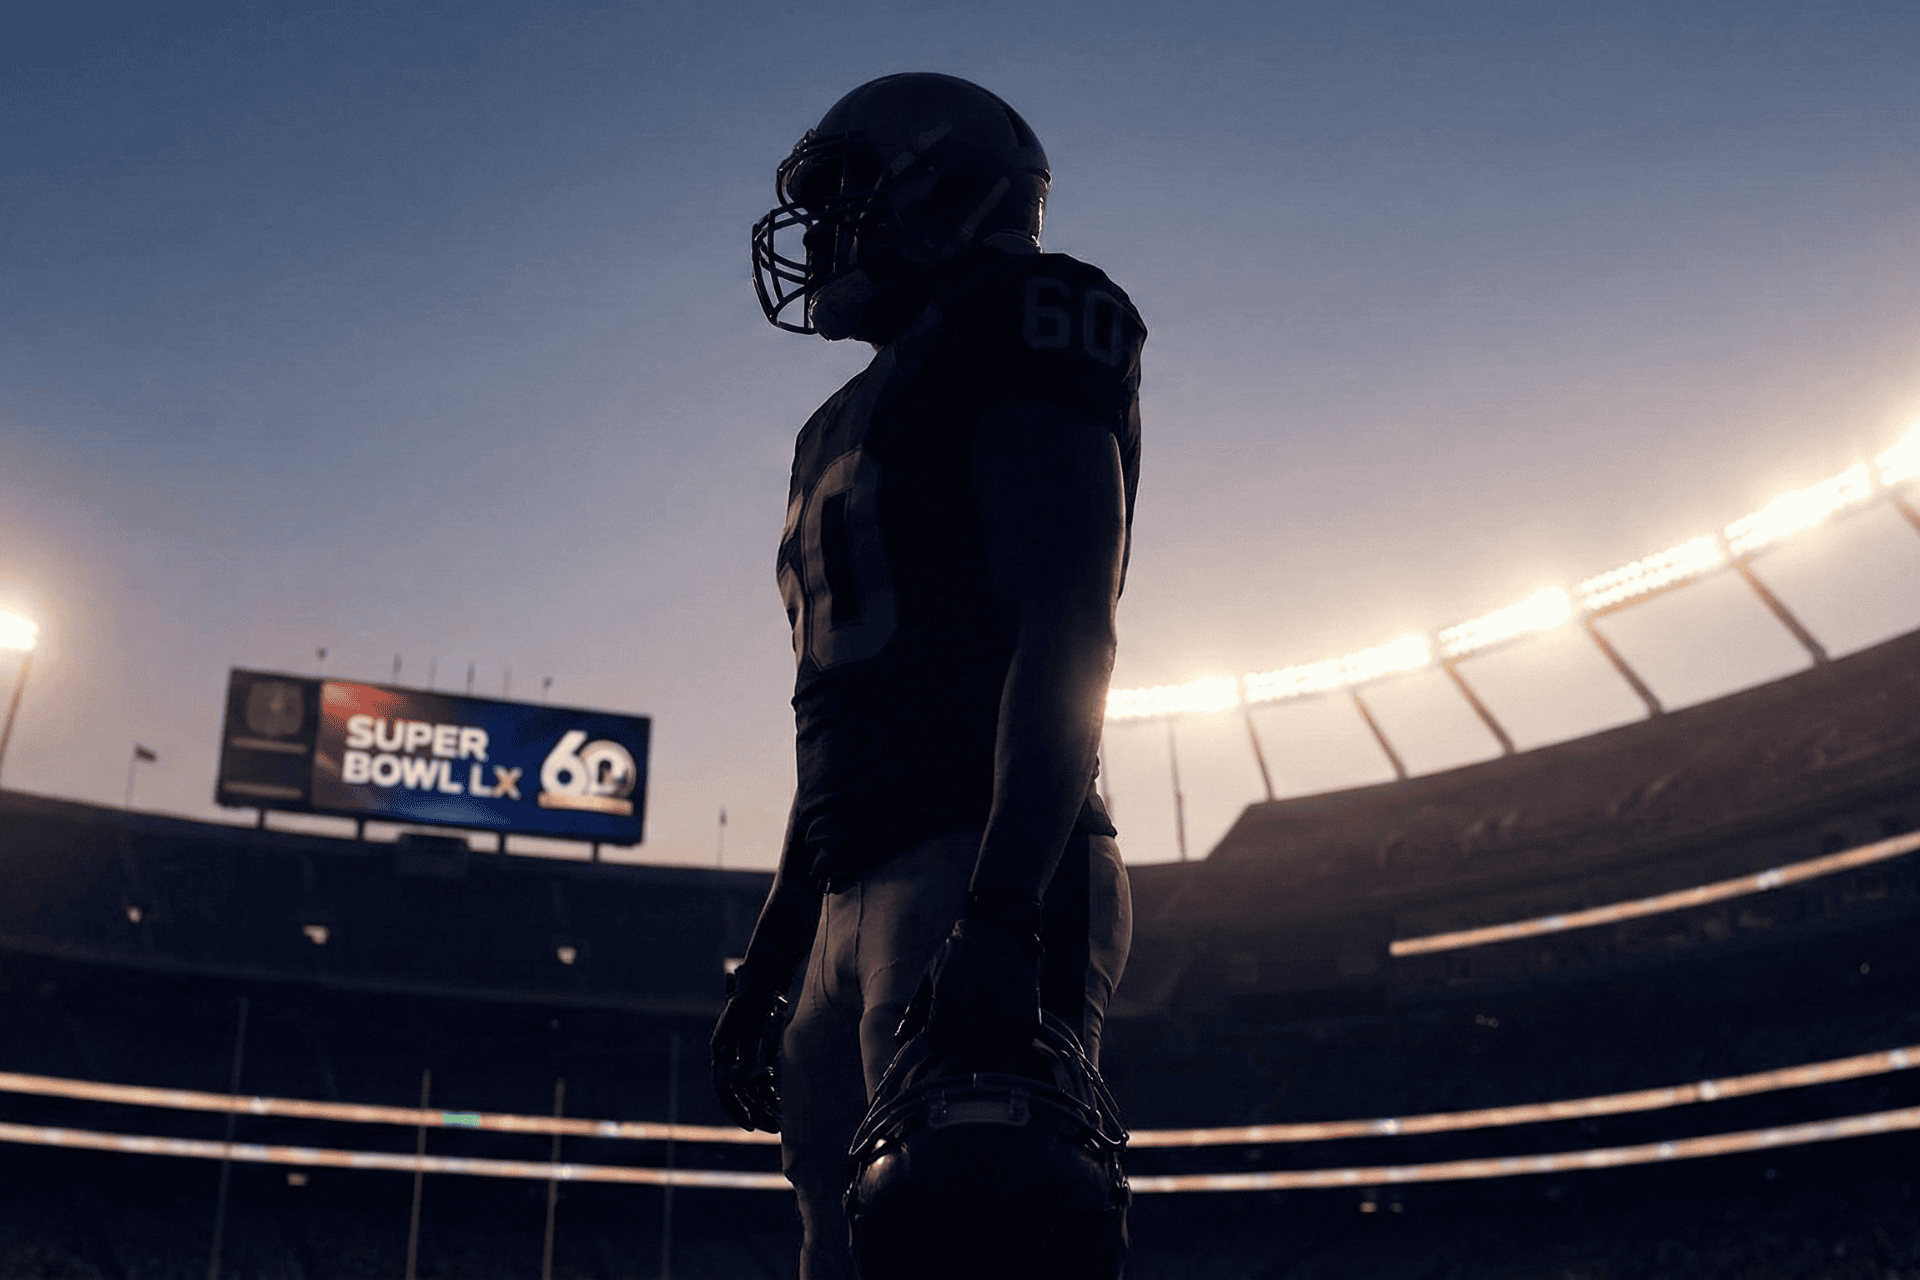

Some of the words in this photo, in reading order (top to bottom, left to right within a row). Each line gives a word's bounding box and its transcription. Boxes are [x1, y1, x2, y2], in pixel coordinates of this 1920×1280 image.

[1023, 277, 1124, 367] 60
[347, 714, 489, 762] SUPER
[342, 751, 463, 794] BOWL
[469, 763, 522, 799] LX
